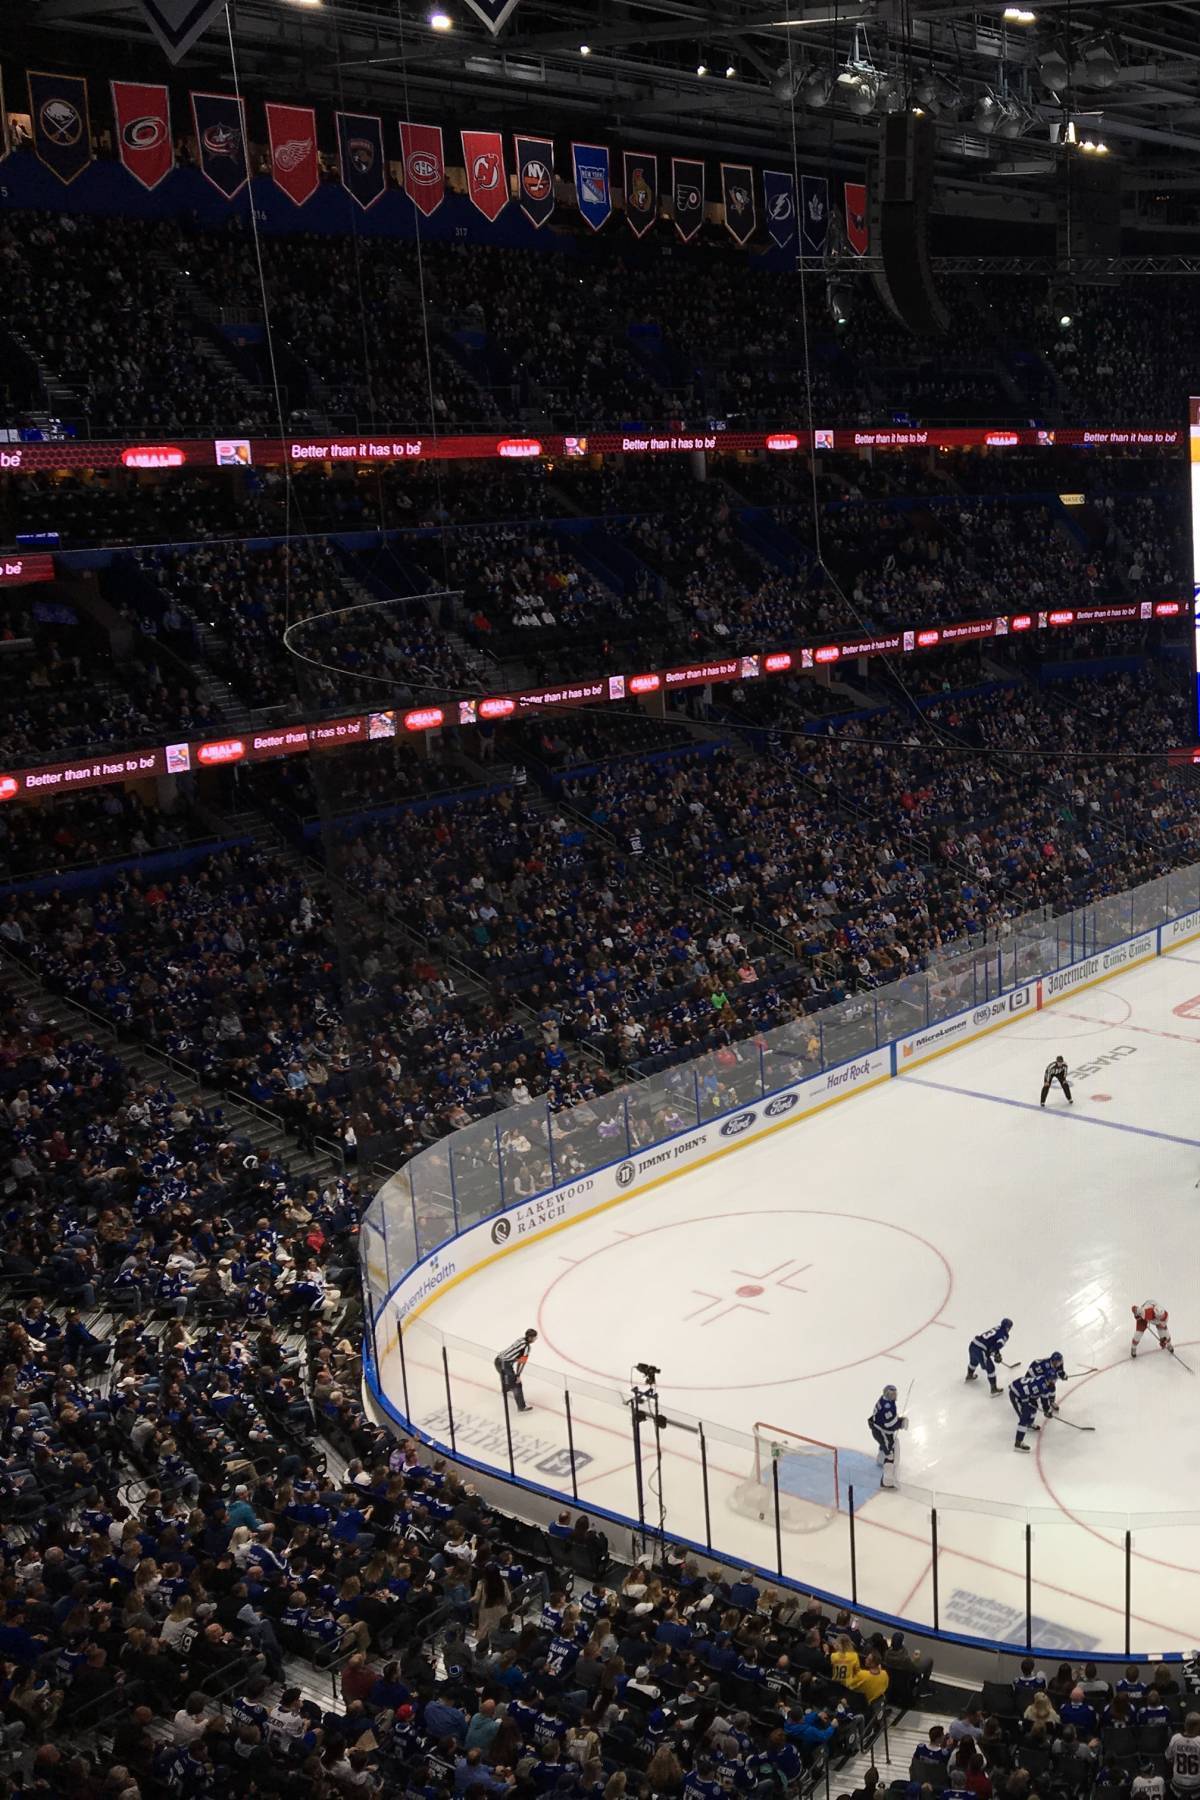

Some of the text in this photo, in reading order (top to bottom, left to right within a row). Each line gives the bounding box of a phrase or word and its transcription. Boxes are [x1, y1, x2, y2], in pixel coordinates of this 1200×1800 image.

[291, 440, 420, 458] Better than it has to be
[622, 436, 716, 451] Better than it has to be
[254, 721, 361, 749] Better than it has to be
[26, 754, 155, 788] Better than it has to be
[1103, 952, 1127, 969] Times
[1128, 939, 1152, 958] Times
[991, 1002, 1006, 1016] SUN
[916, 1020, 967, 1047] MicroLumen
[826, 1059, 871, 1090] Hard Rock
[1068, 1044, 1138, 1081] CHASE
[637, 1135, 708, 1174] JIMMY JOHN'S
[516, 1179, 595, 1221] LAKEWOOD
[517, 1205, 567, 1234] RANCH
[1176, 1752, 1200, 1776] 86
